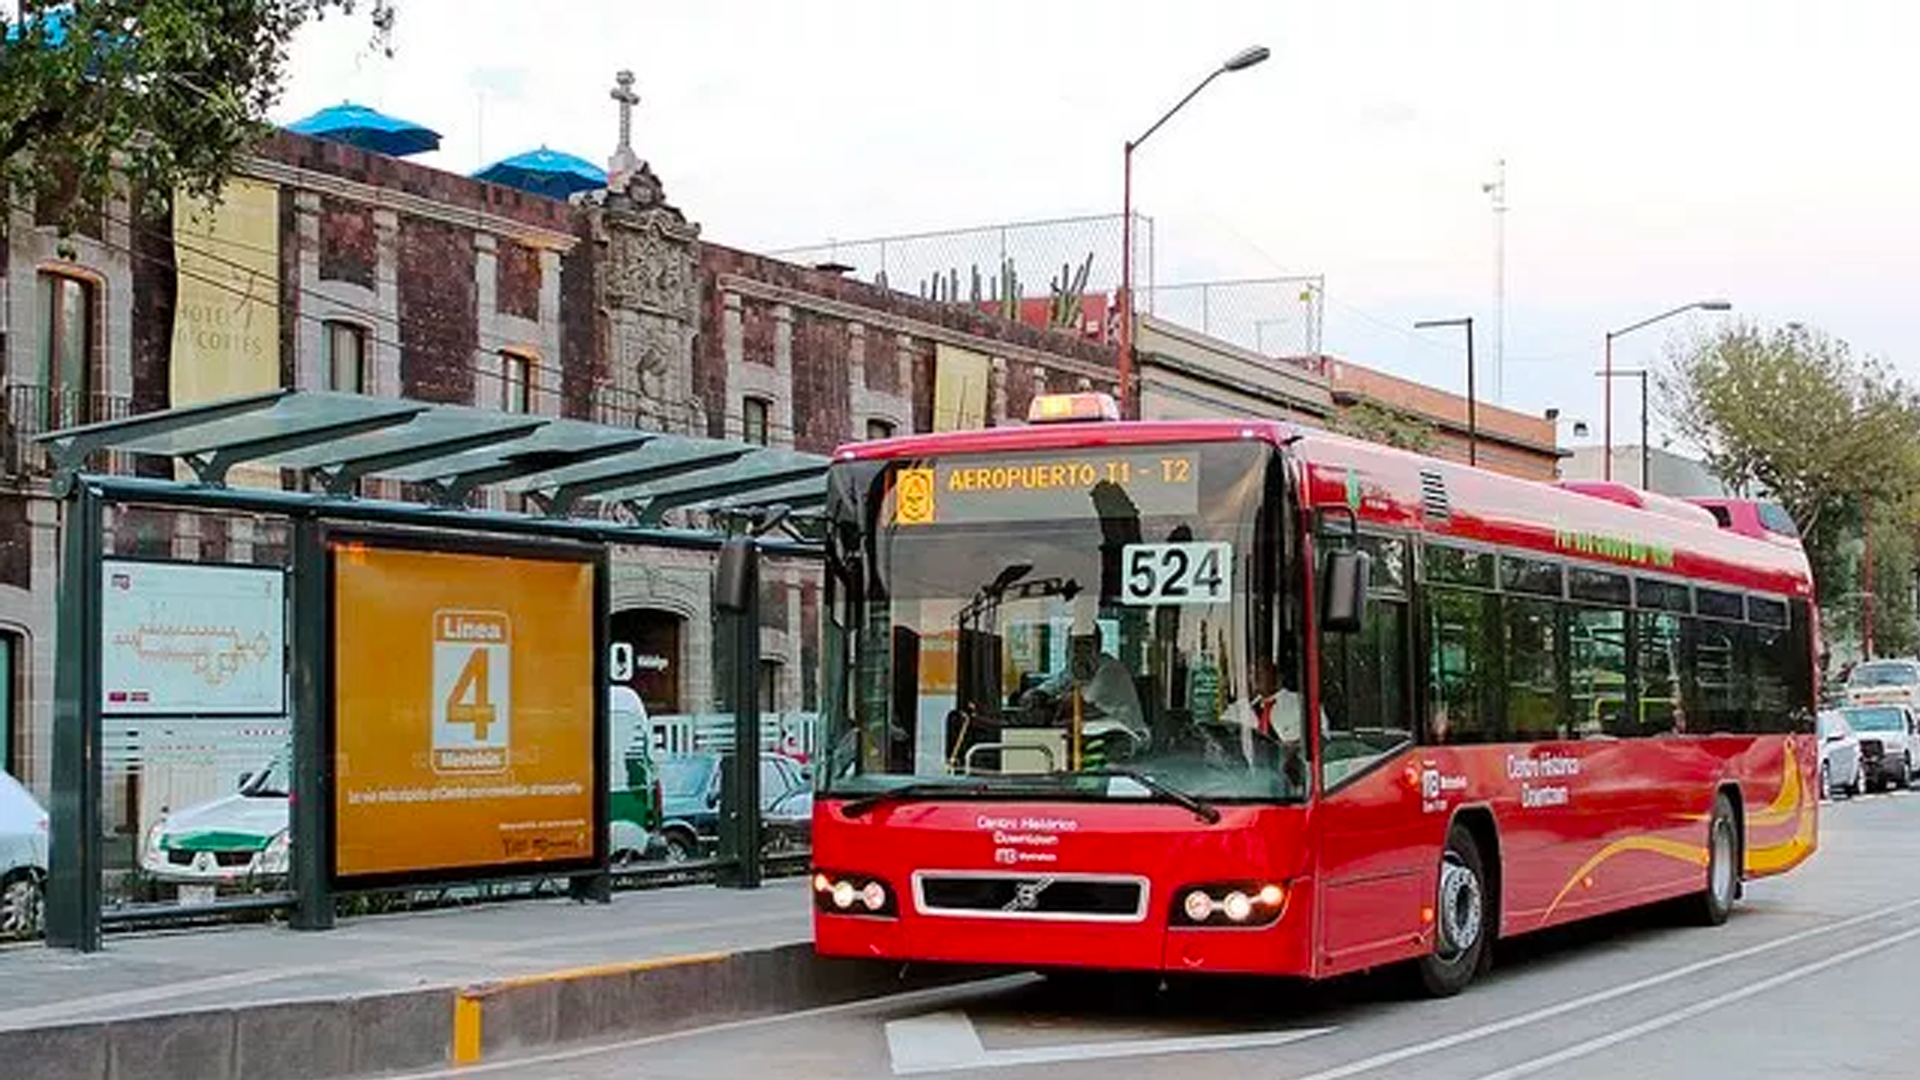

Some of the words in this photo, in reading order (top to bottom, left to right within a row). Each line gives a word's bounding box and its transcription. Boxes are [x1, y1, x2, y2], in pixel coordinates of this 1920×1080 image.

[949, 462, 1095, 491] AEROPUERTO
[1106, 461, 1131, 485] T1
[1160, 458, 1191, 483] T2
[1129, 547, 1222, 598] 524
[446, 648, 496, 740] 4
